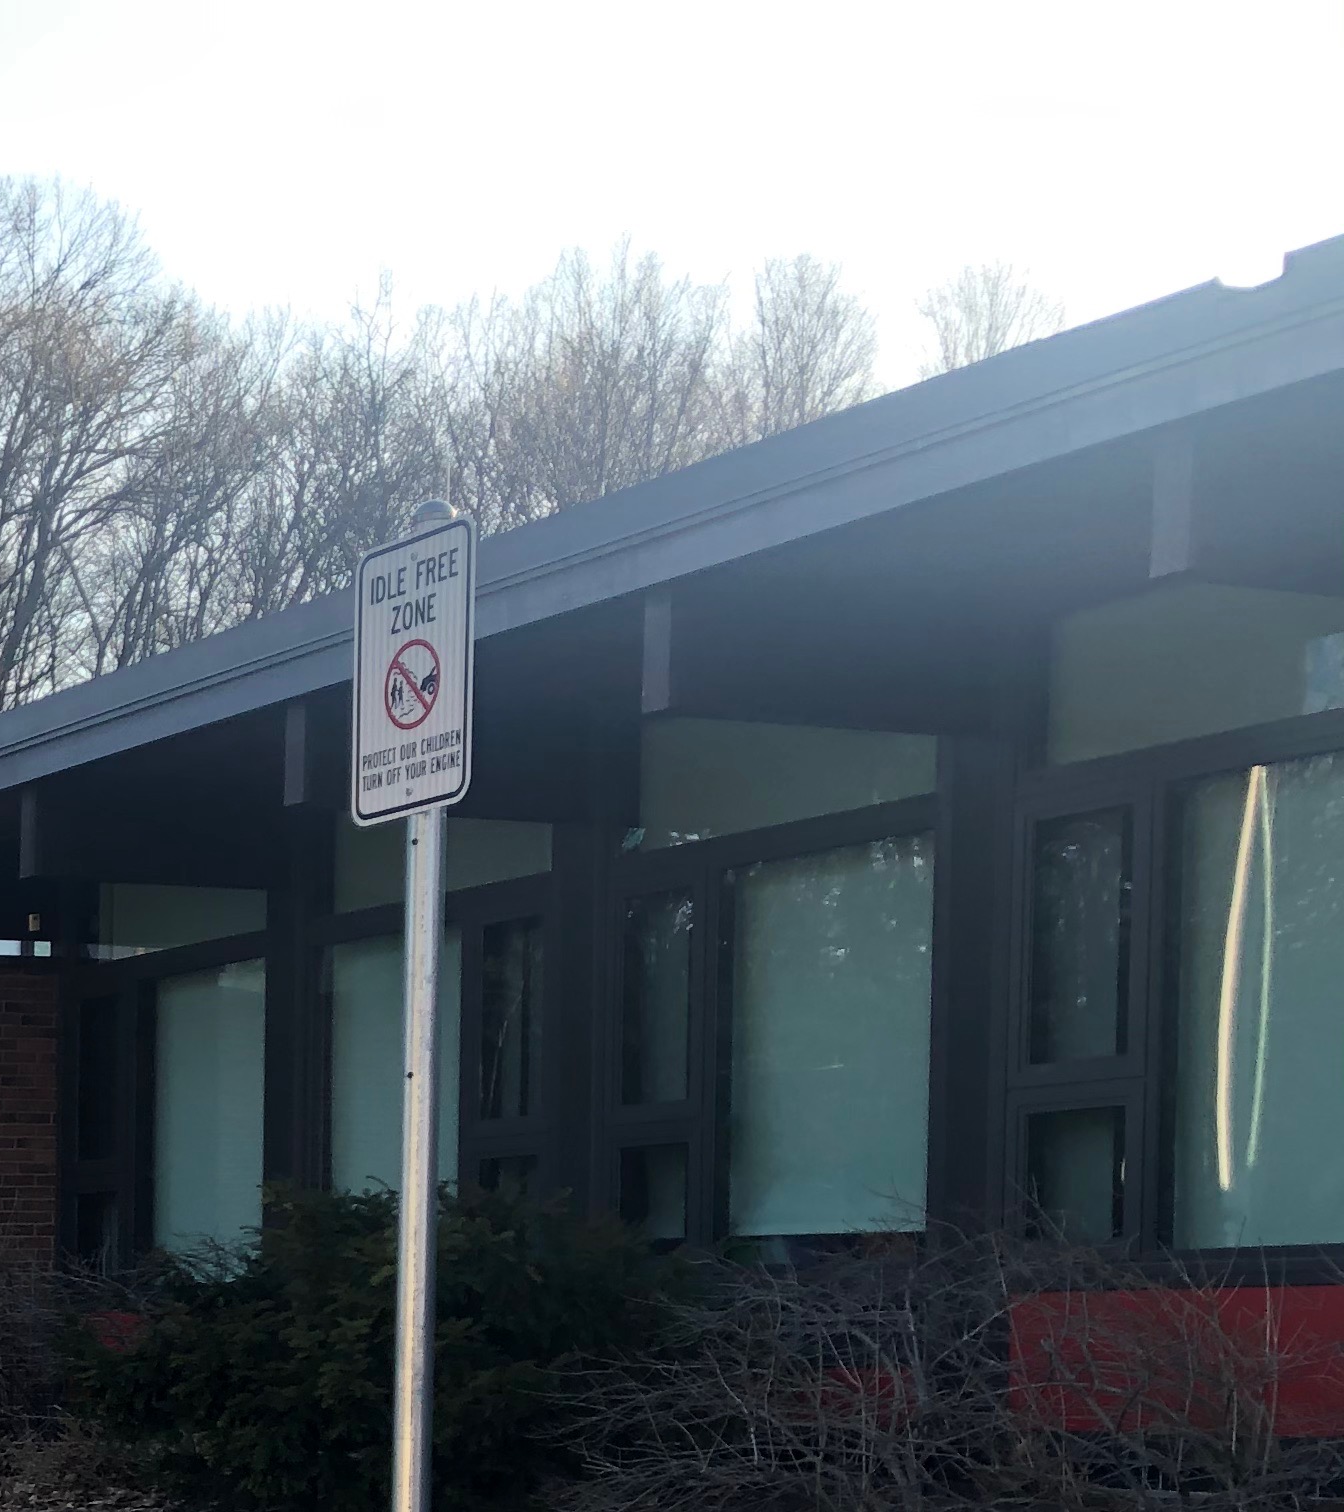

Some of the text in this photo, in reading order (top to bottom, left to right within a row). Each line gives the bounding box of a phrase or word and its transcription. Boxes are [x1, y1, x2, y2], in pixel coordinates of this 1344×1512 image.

[370, 547, 459, 606] IDLE FREE
[391, 592, 437, 635] ZONE
[362, 728, 461, 772] PROTECT OUR CHILDREN
[362, 749, 461, 793] TURN OFF YOUR ENGINE
